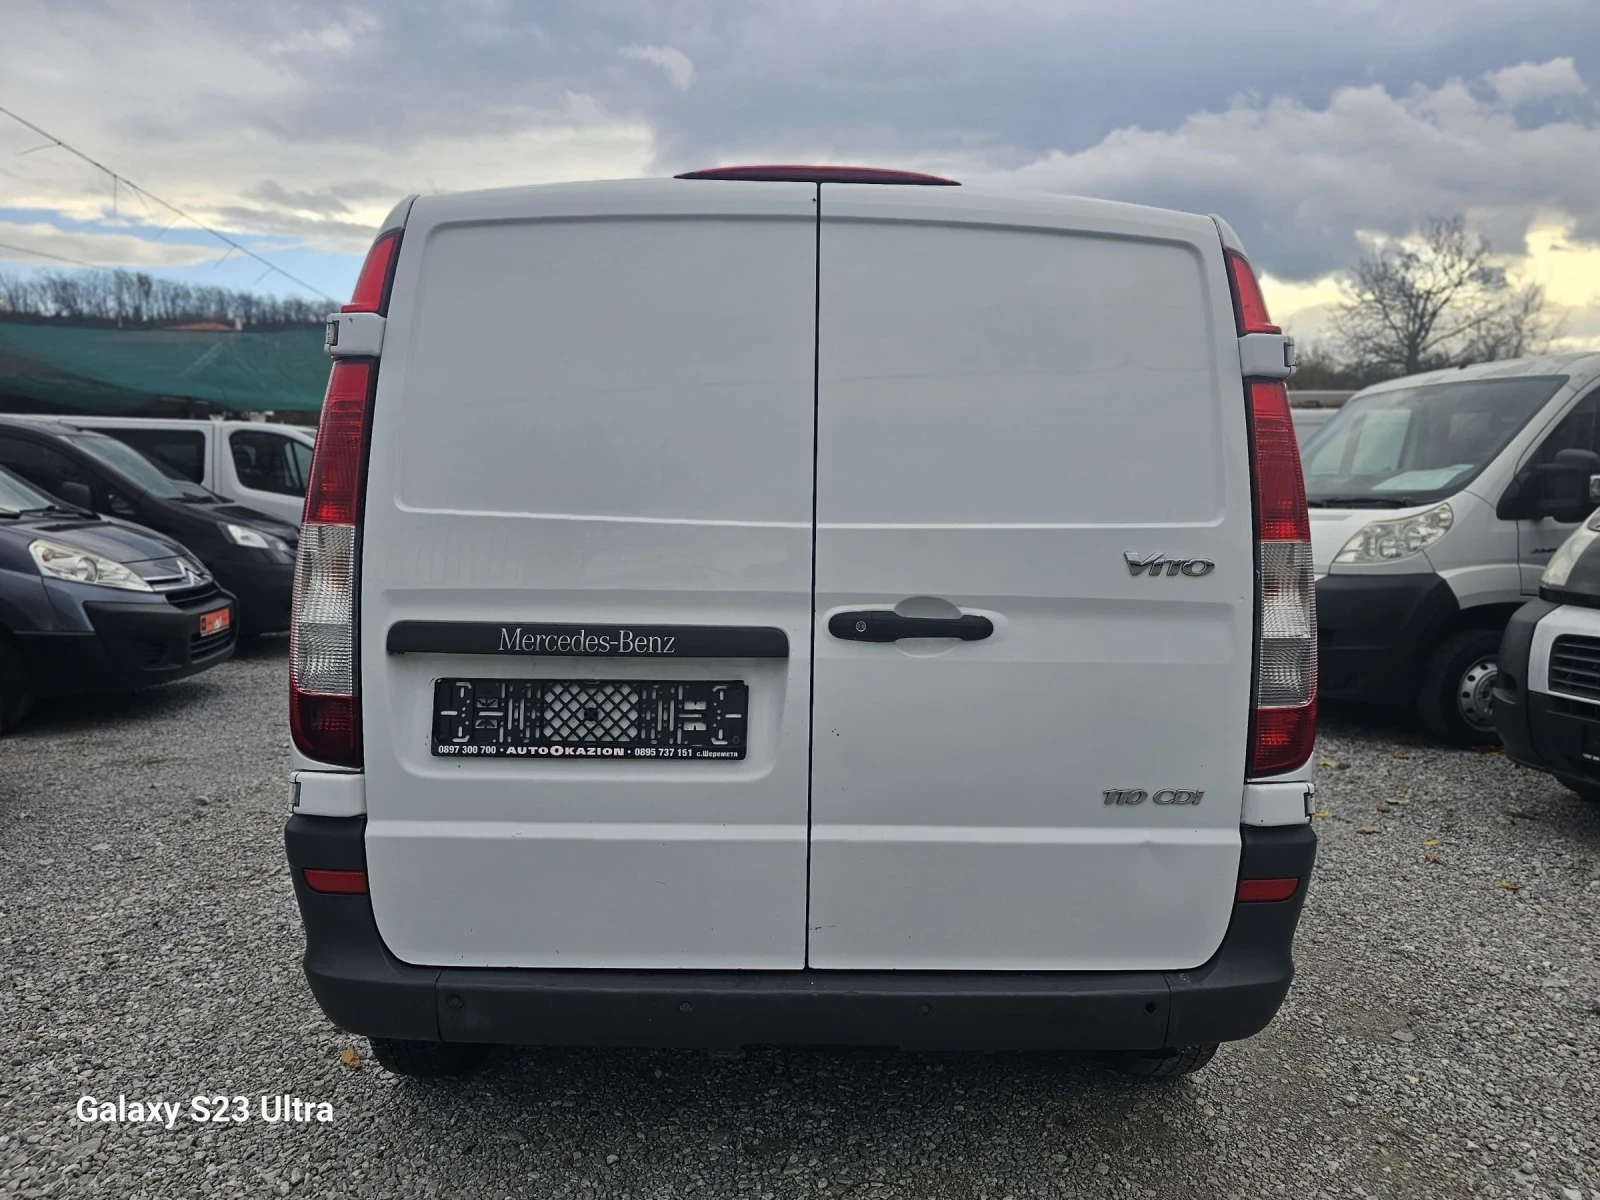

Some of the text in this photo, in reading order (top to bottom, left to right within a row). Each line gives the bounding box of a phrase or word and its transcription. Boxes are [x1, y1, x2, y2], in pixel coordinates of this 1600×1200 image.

[498, 627, 677, 654] Mercedes-Benz
[438, 745, 459, 754] 0897
[461, 745, 478, 754] 300
[480, 745, 497, 754] 700
[634, 748, 656, 757] 0895
[658, 748, 674, 757] 737
[677, 748, 692, 757] 151
[1103, 788, 1205, 805] 110 CDI
